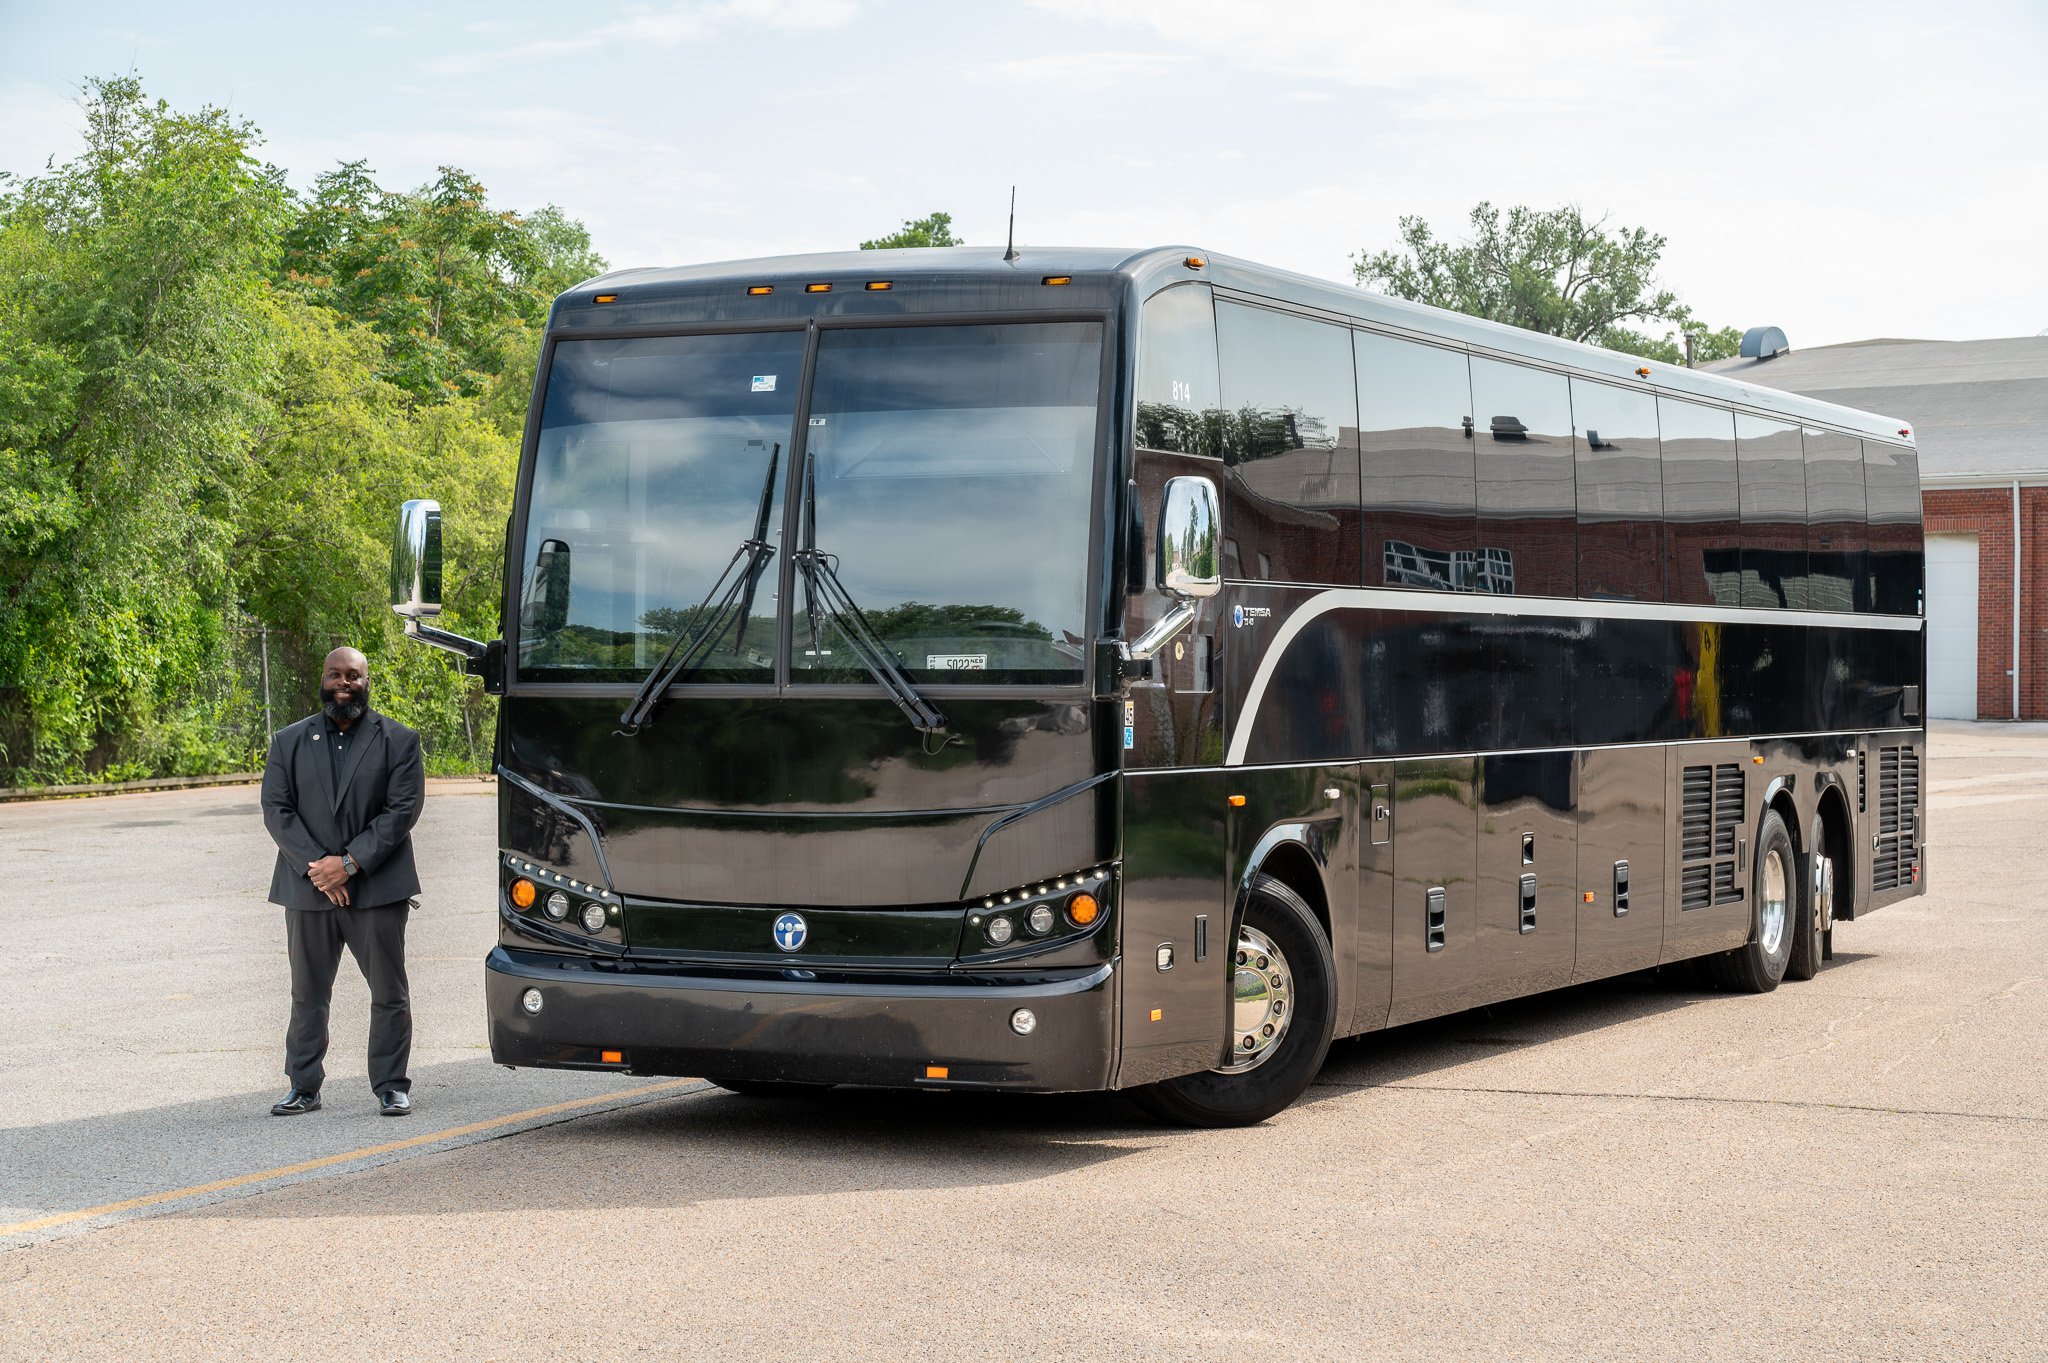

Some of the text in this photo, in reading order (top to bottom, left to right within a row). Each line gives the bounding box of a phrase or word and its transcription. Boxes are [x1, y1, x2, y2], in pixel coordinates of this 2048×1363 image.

[1172, 380, 1191, 403] 814
[1243, 607, 1271, 617] TEMSA
[947, 659, 970, 670] 5022
